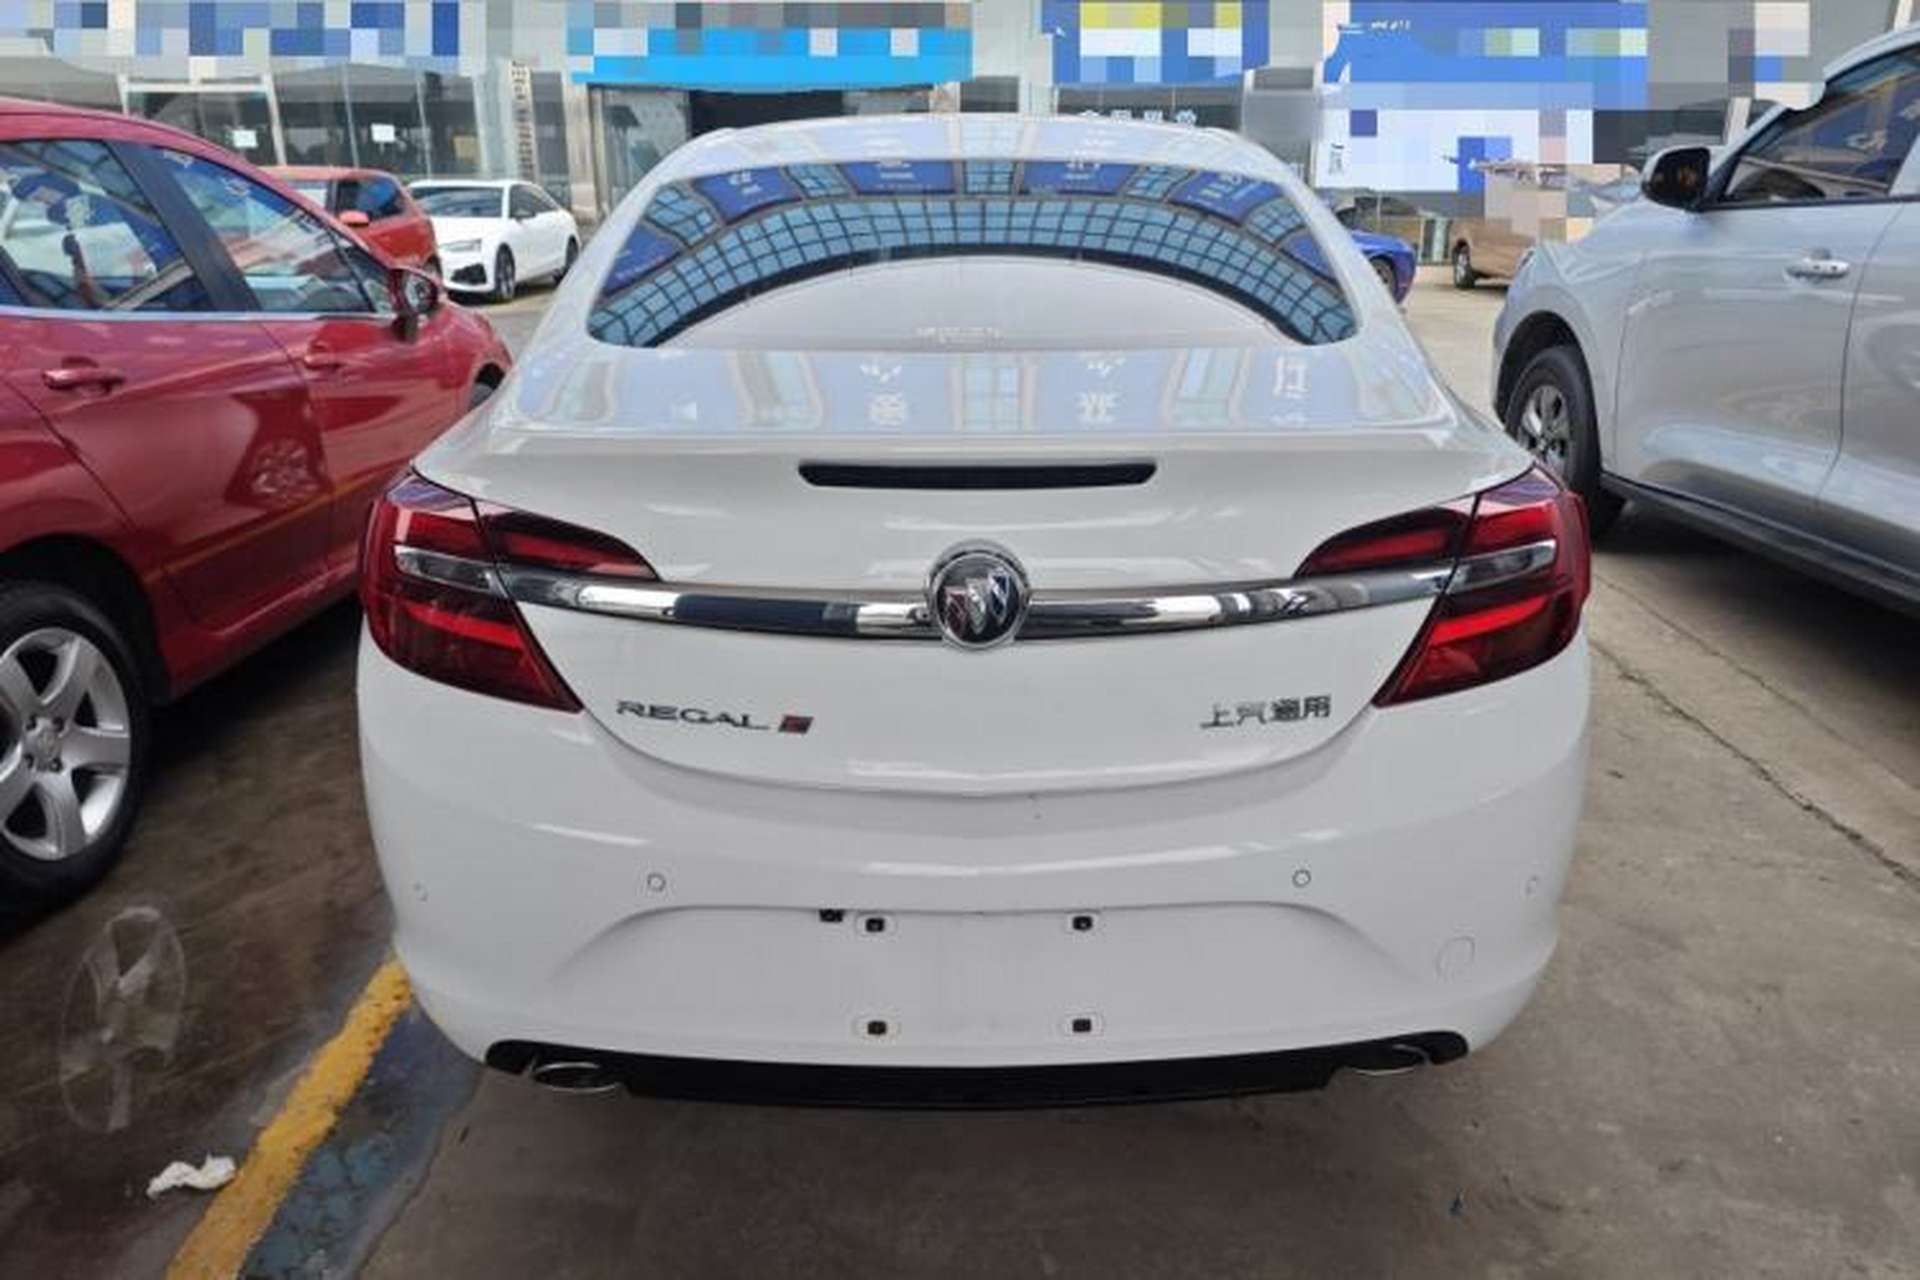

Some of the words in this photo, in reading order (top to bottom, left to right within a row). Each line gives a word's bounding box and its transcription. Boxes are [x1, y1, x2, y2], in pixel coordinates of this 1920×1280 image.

[616, 700, 770, 731] REGAL
[1199, 695, 1331, 729] 上汽通用
